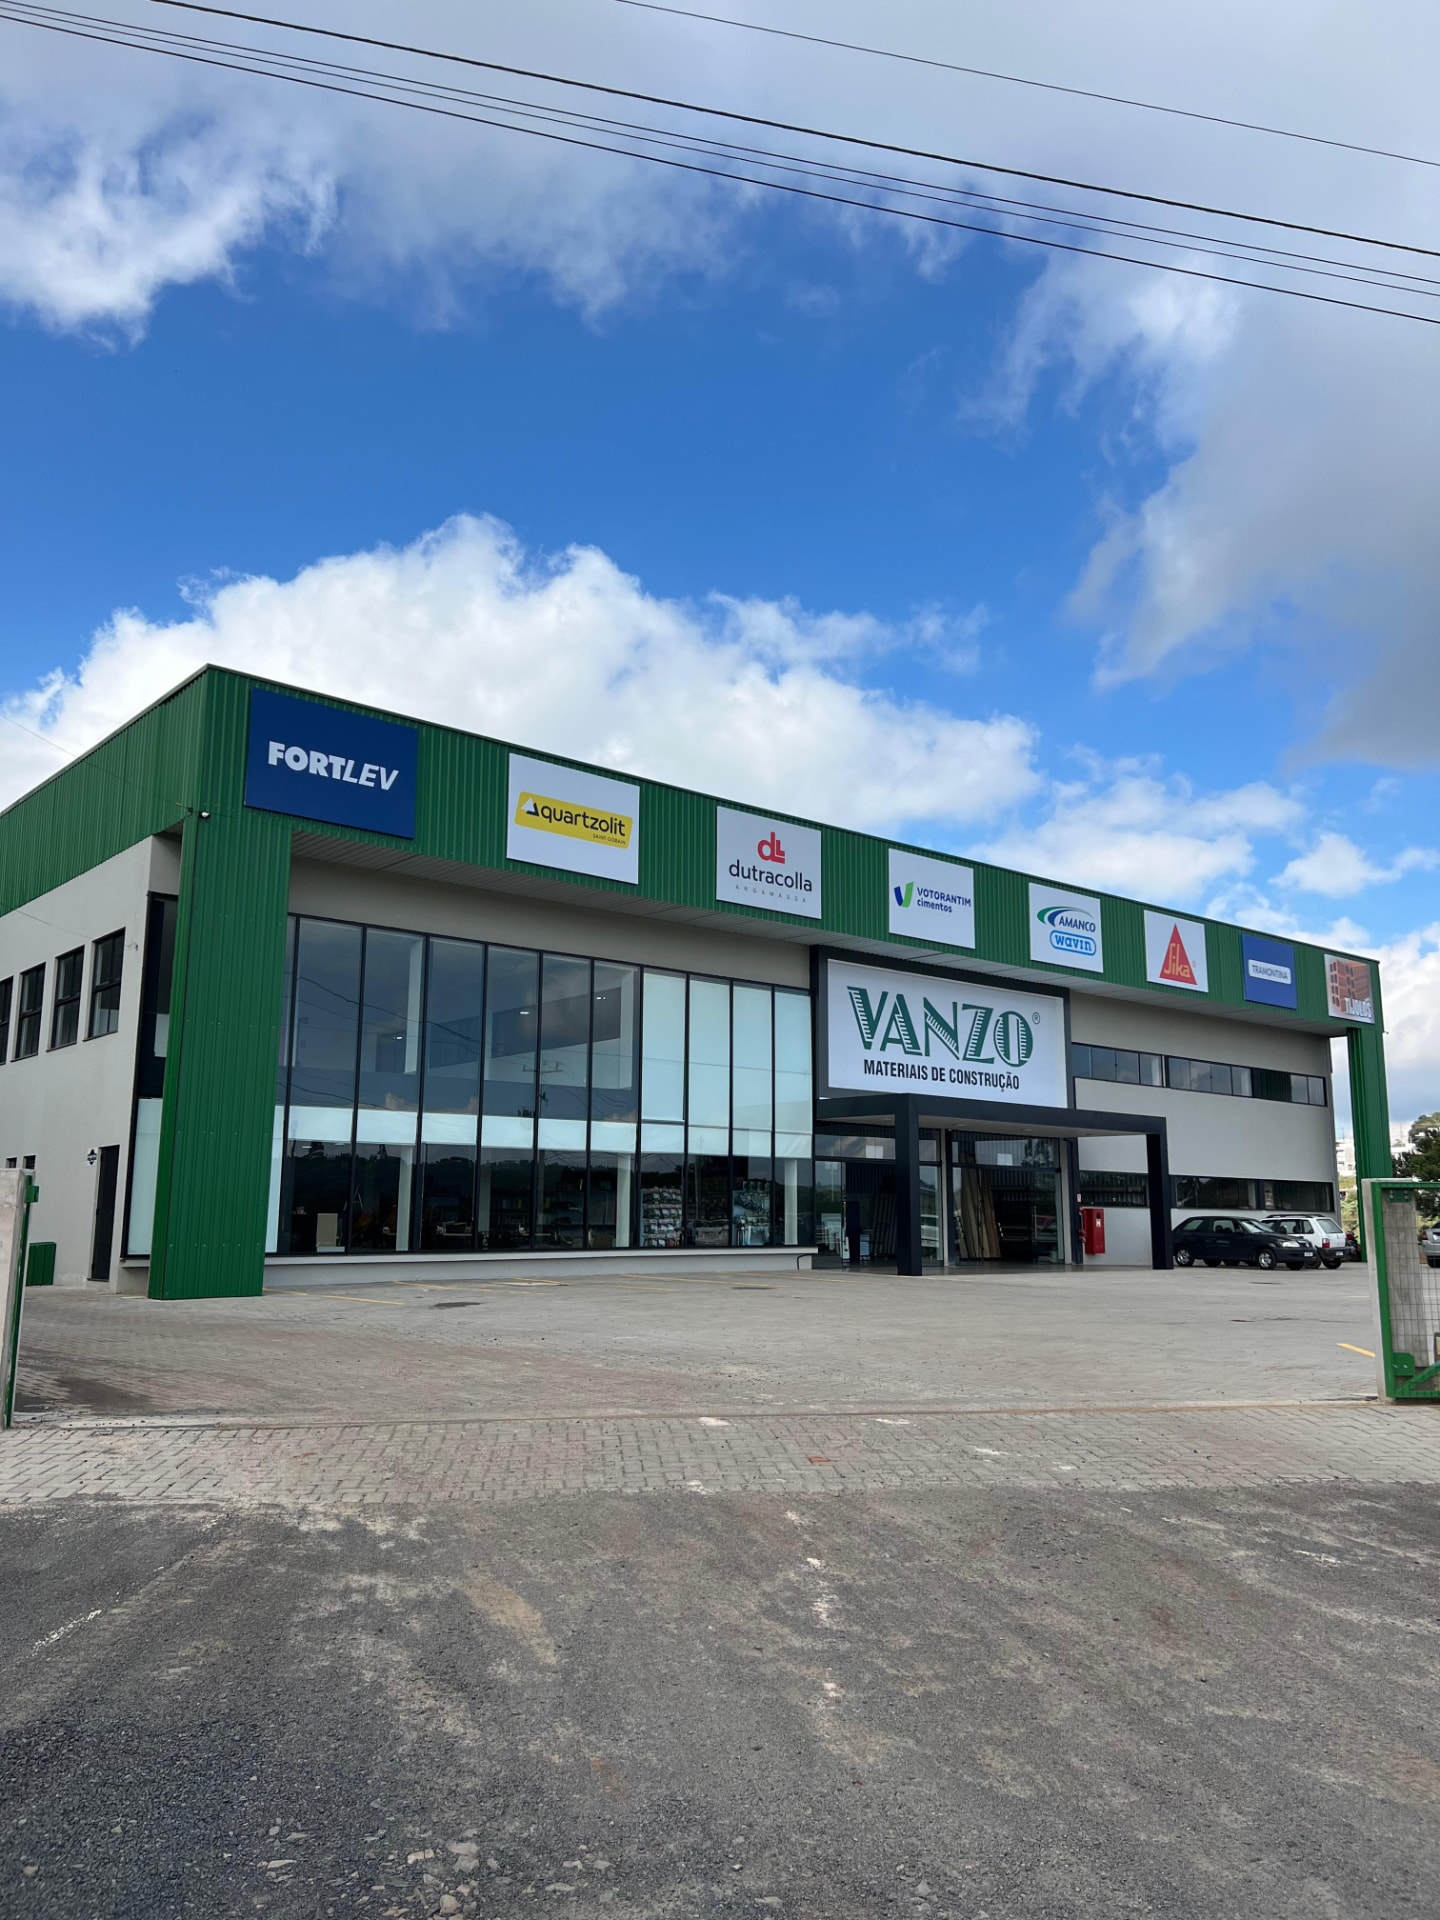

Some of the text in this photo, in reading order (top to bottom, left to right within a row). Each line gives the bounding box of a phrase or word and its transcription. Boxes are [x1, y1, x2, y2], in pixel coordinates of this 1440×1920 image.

[268, 741, 399, 790] FORTLEV
[540, 805, 626, 837] quartzolit
[728, 859, 812, 892] dutracolla
[917, 886, 971, 907] VOTORANTIM
[917, 897, 952, 913] cimentos
[1059, 915, 1096, 933] AMANCO
[1054, 934, 1092, 952] wavin
[1163, 942, 1191, 978] Sika
[1251, 964, 1289, 980] TRAMONTINA
[846, 985, 1034, 1068] VANZO
[863, 1059, 1020, 1092] MATERIAIS DE CONSTRUÇÃO
